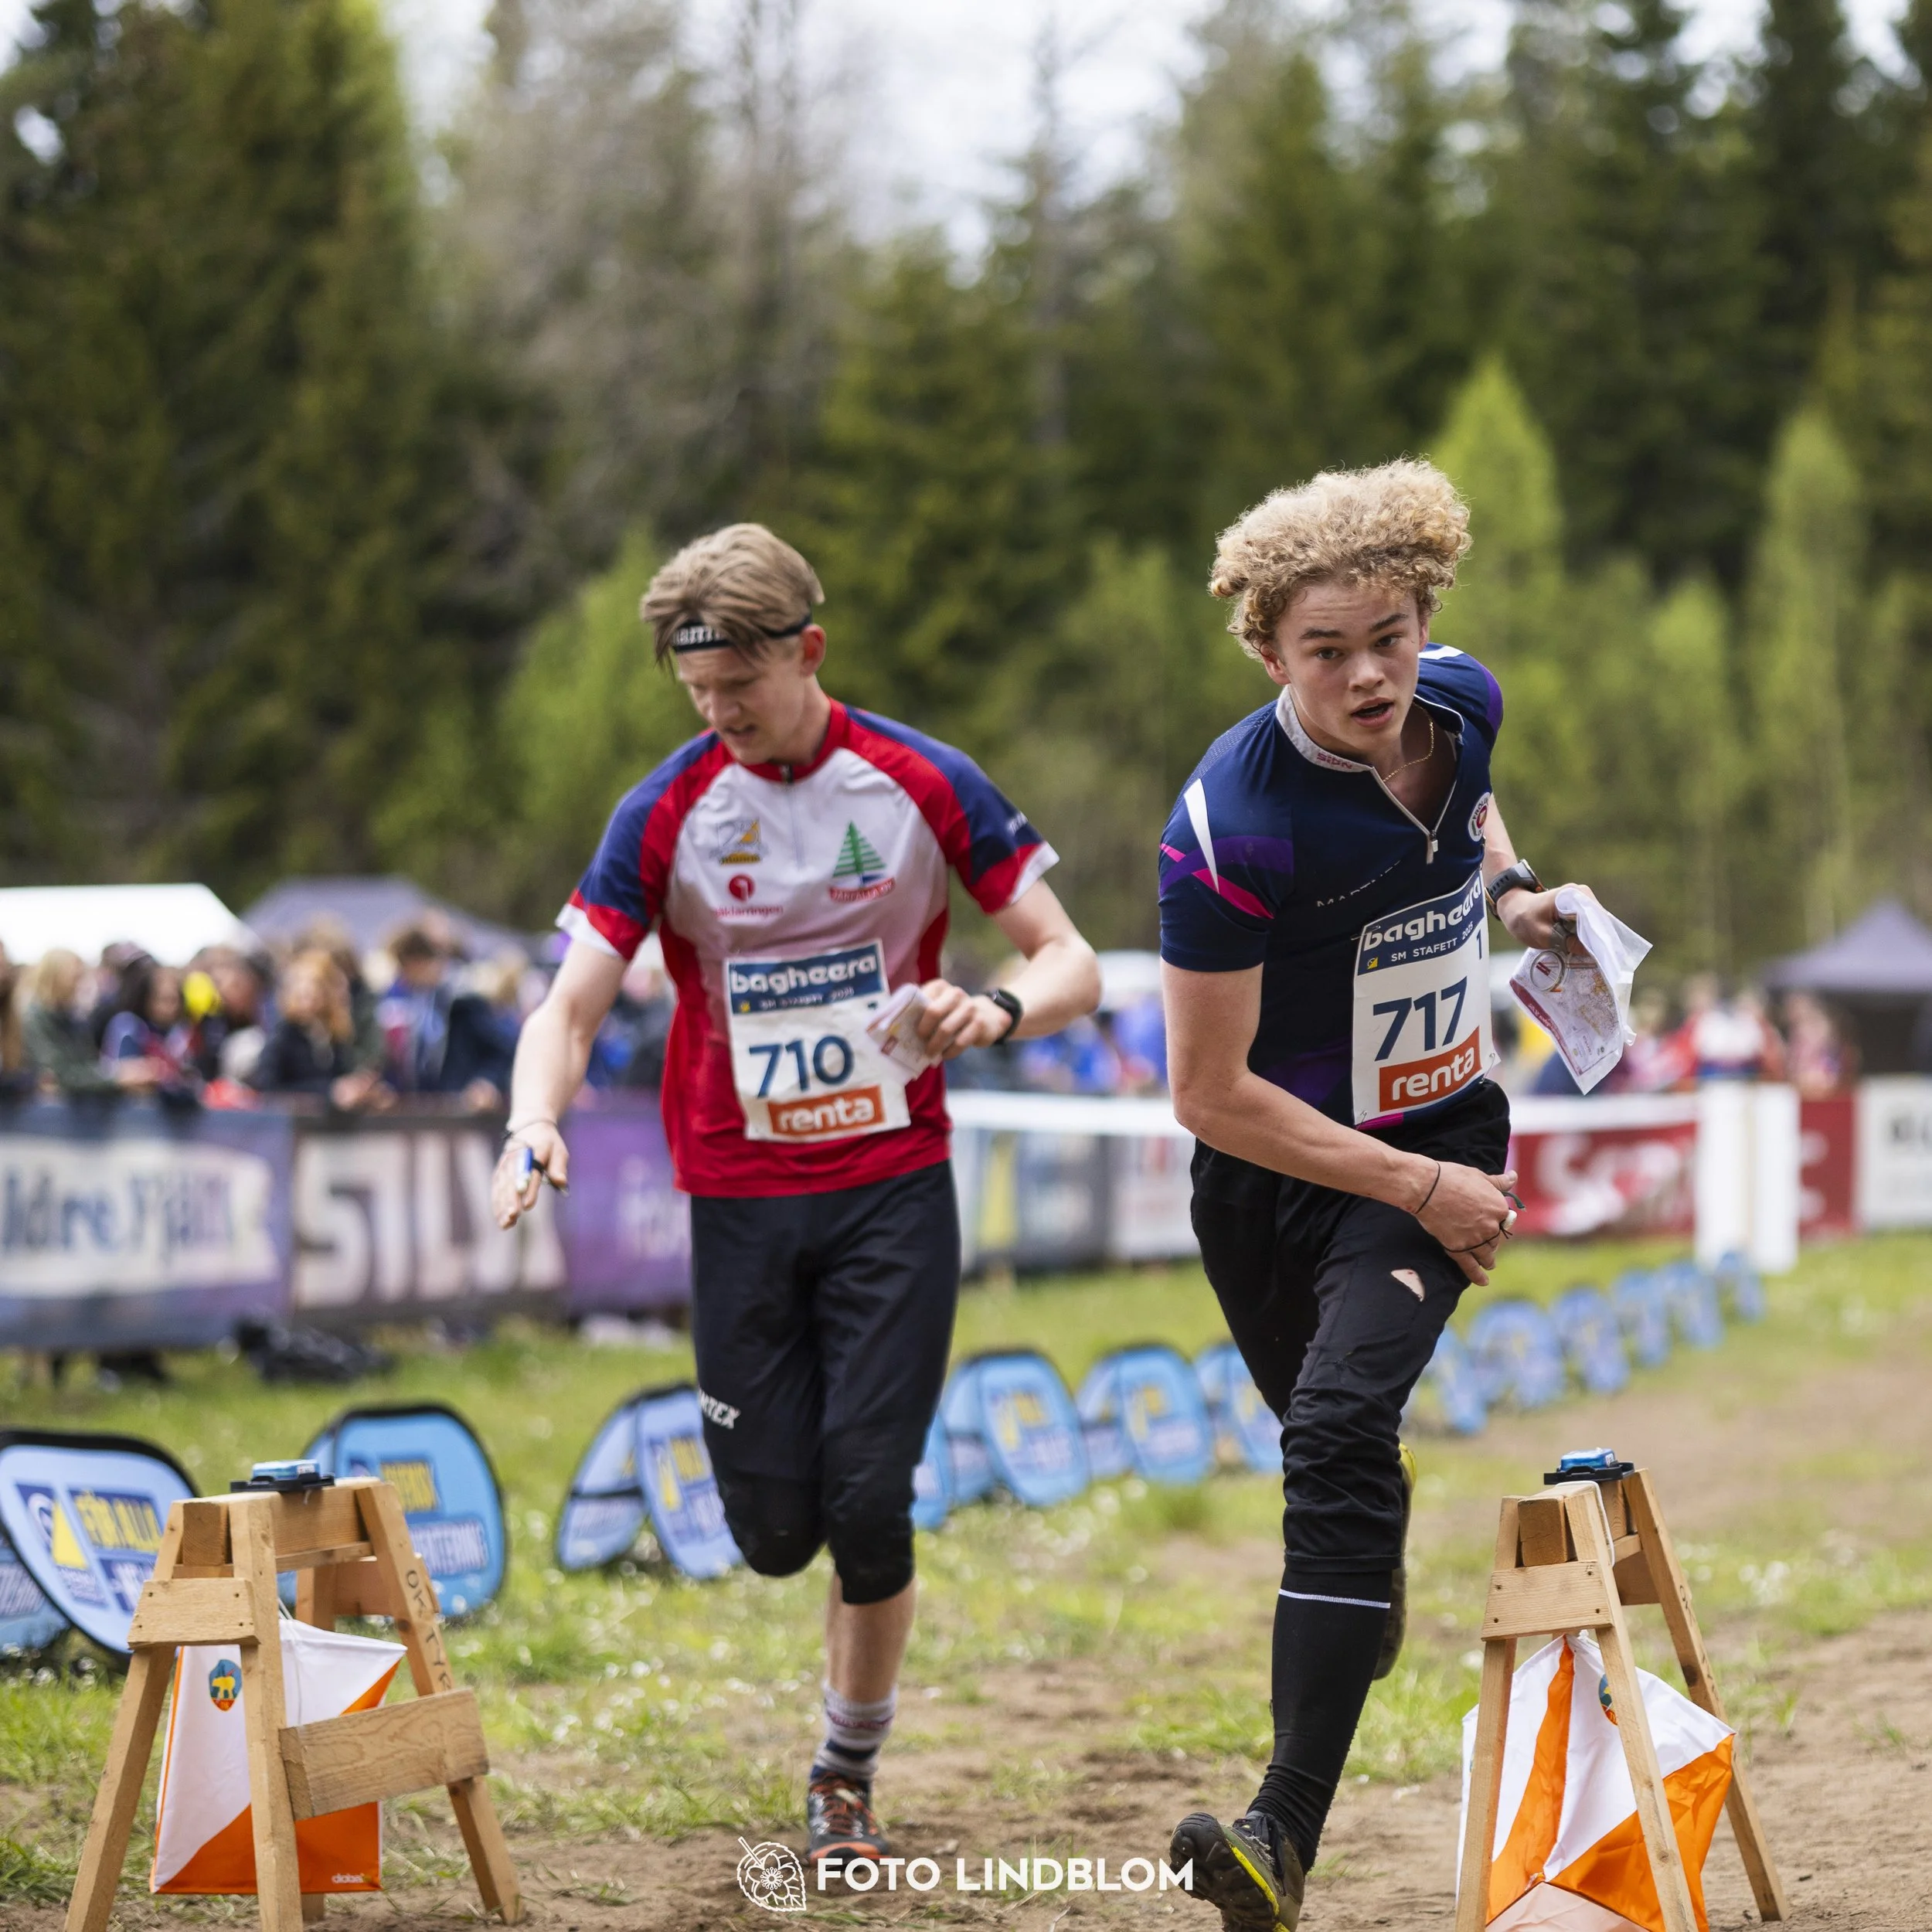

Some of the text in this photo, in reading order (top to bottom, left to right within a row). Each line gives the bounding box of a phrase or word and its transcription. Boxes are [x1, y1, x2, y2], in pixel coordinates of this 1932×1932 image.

[1363, 876, 1481, 951] bagheera
[1391, 951, 1406, 962] SM
[1413, 937, 1458, 957] STAFETT
[1476, 929, 1482, 961] 1
[730, 954, 877, 995] bagheera
[1373, 976, 1467, 1061] 717
[749, 1035, 854, 1098] 710
[1393, 1047, 1475, 1100] renta
[777, 1097, 876, 1131] renta
